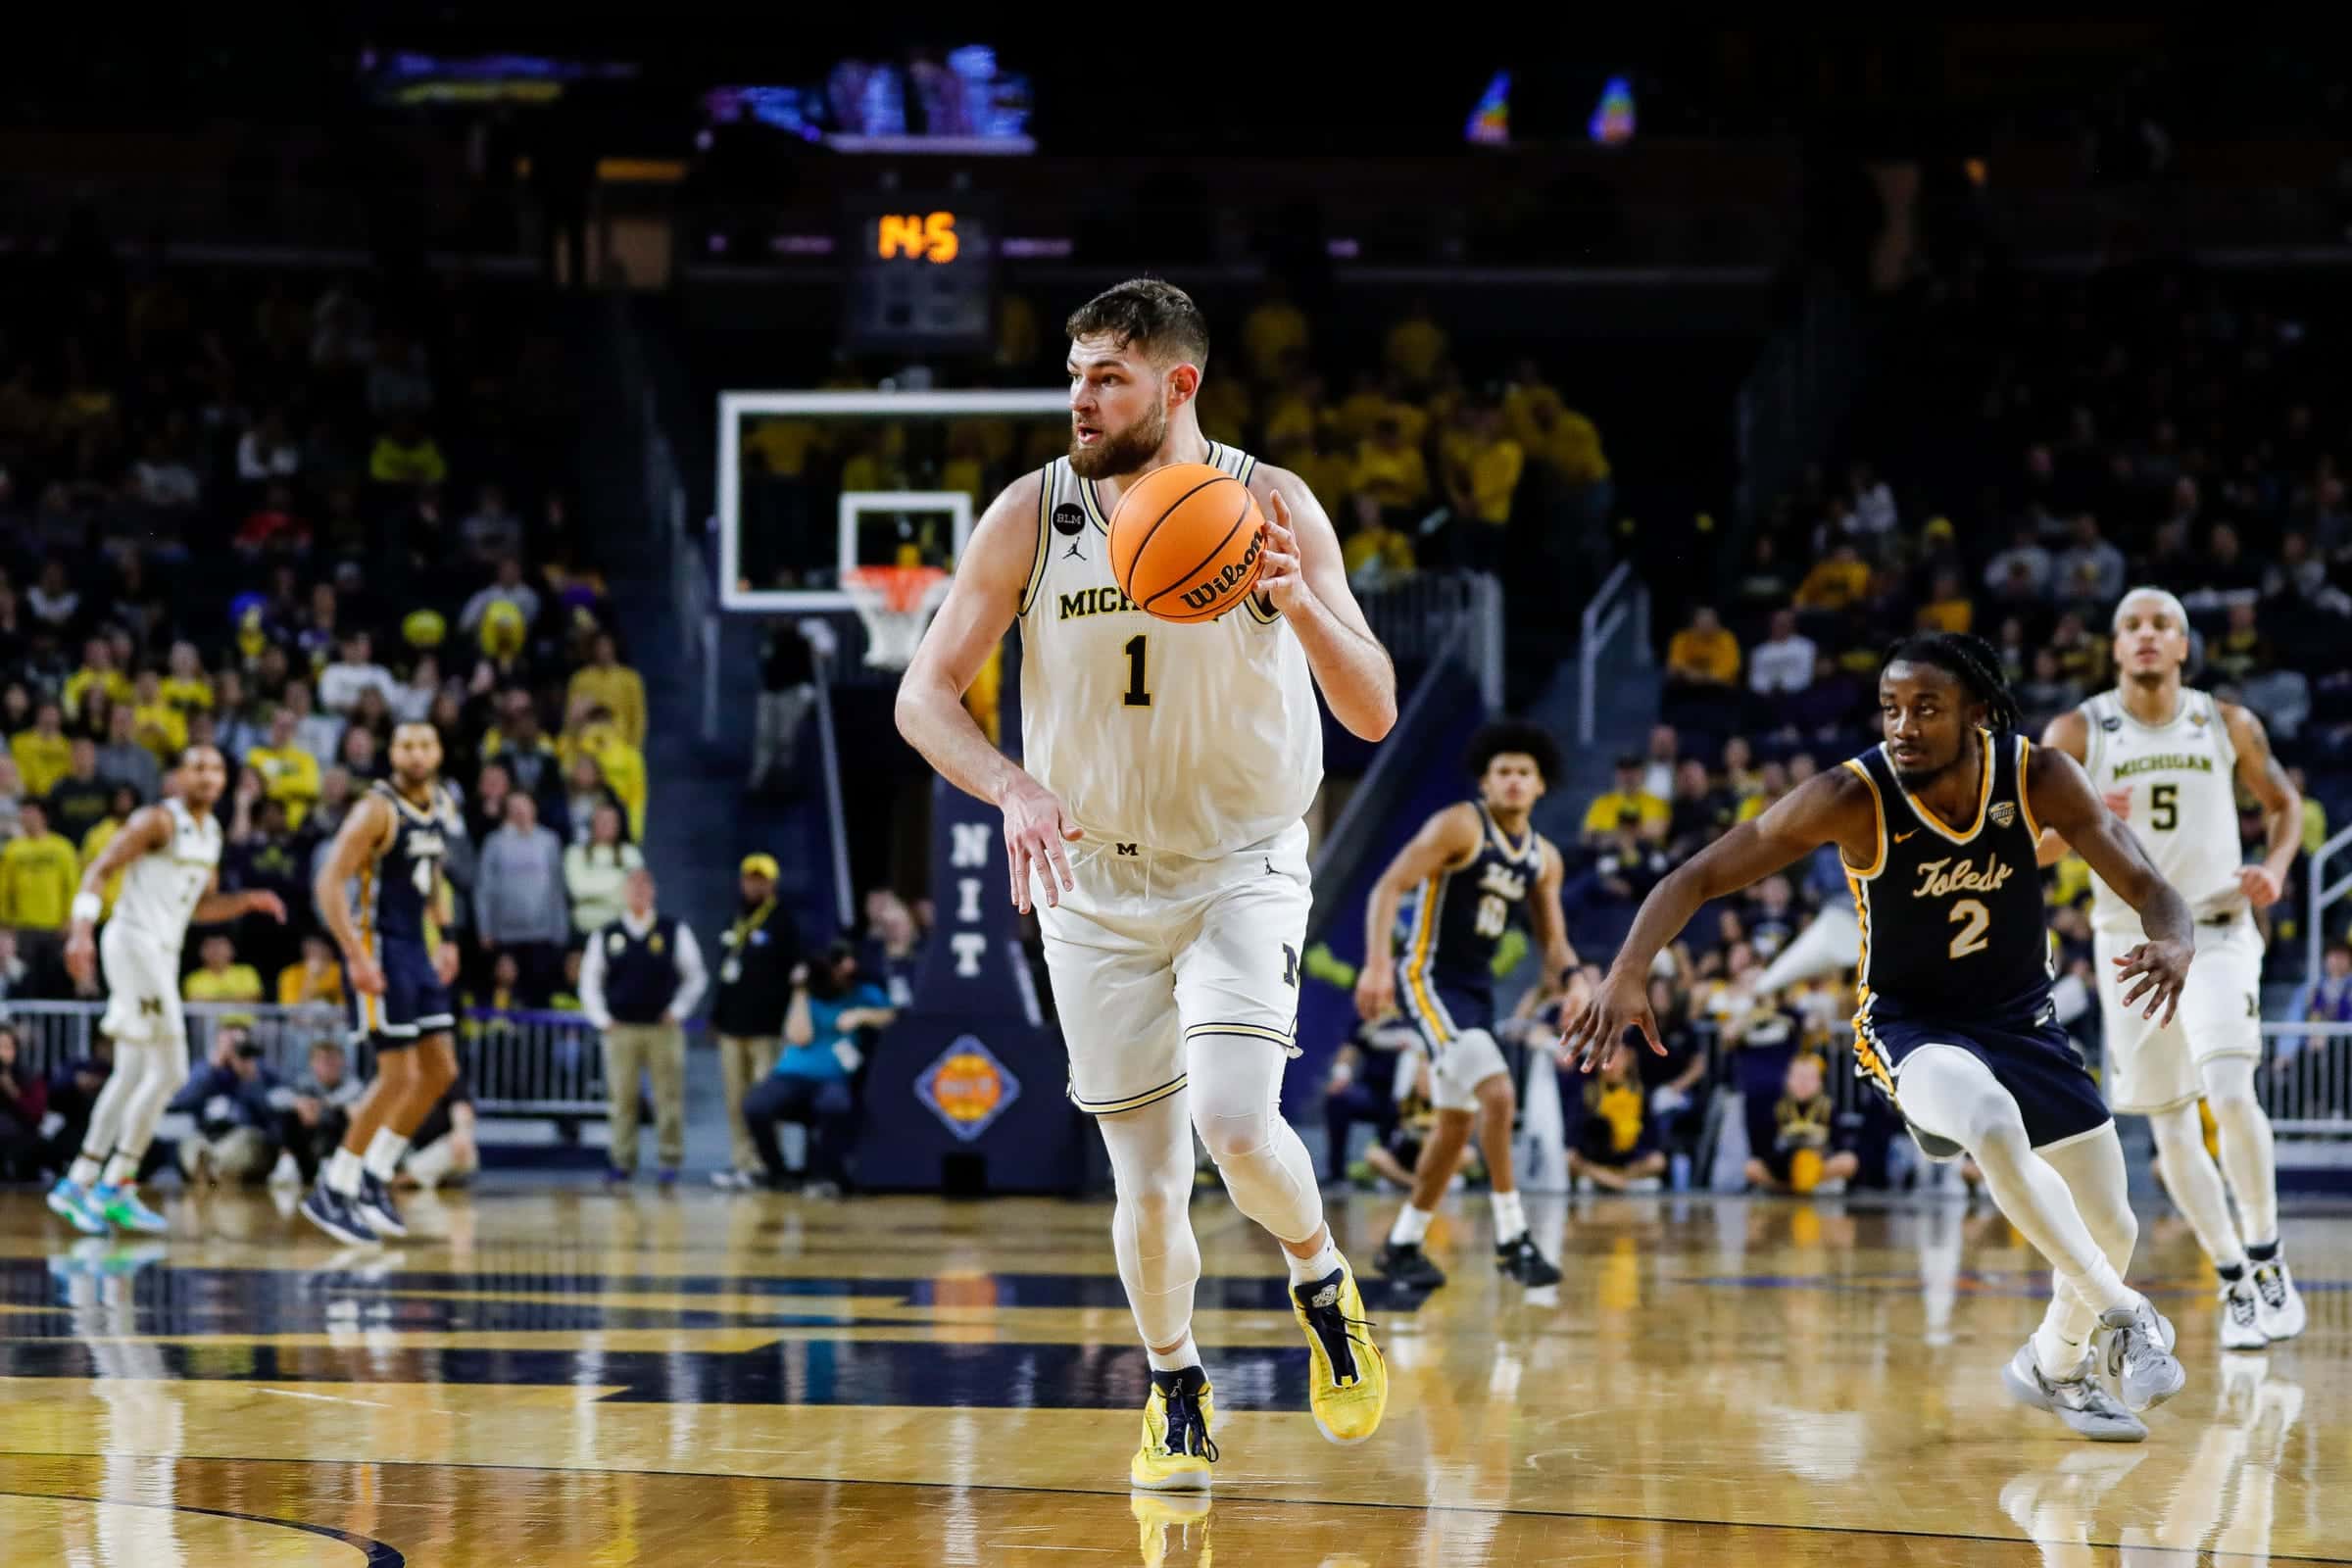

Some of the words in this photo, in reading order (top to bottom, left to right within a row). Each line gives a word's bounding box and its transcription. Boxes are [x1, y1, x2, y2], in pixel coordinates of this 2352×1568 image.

[1056, 513, 1082, 525] BLM
[1179, 530, 1264, 610] Wilson
[1122, 633, 1152, 708] 1
[2113, 755, 2213, 782] MICHIGAN
[2150, 783, 2180, 832] 5
[1115, 842, 1140, 857] M
[949, 822, 992, 977] NIT
[1948, 898, 1991, 960] 2
